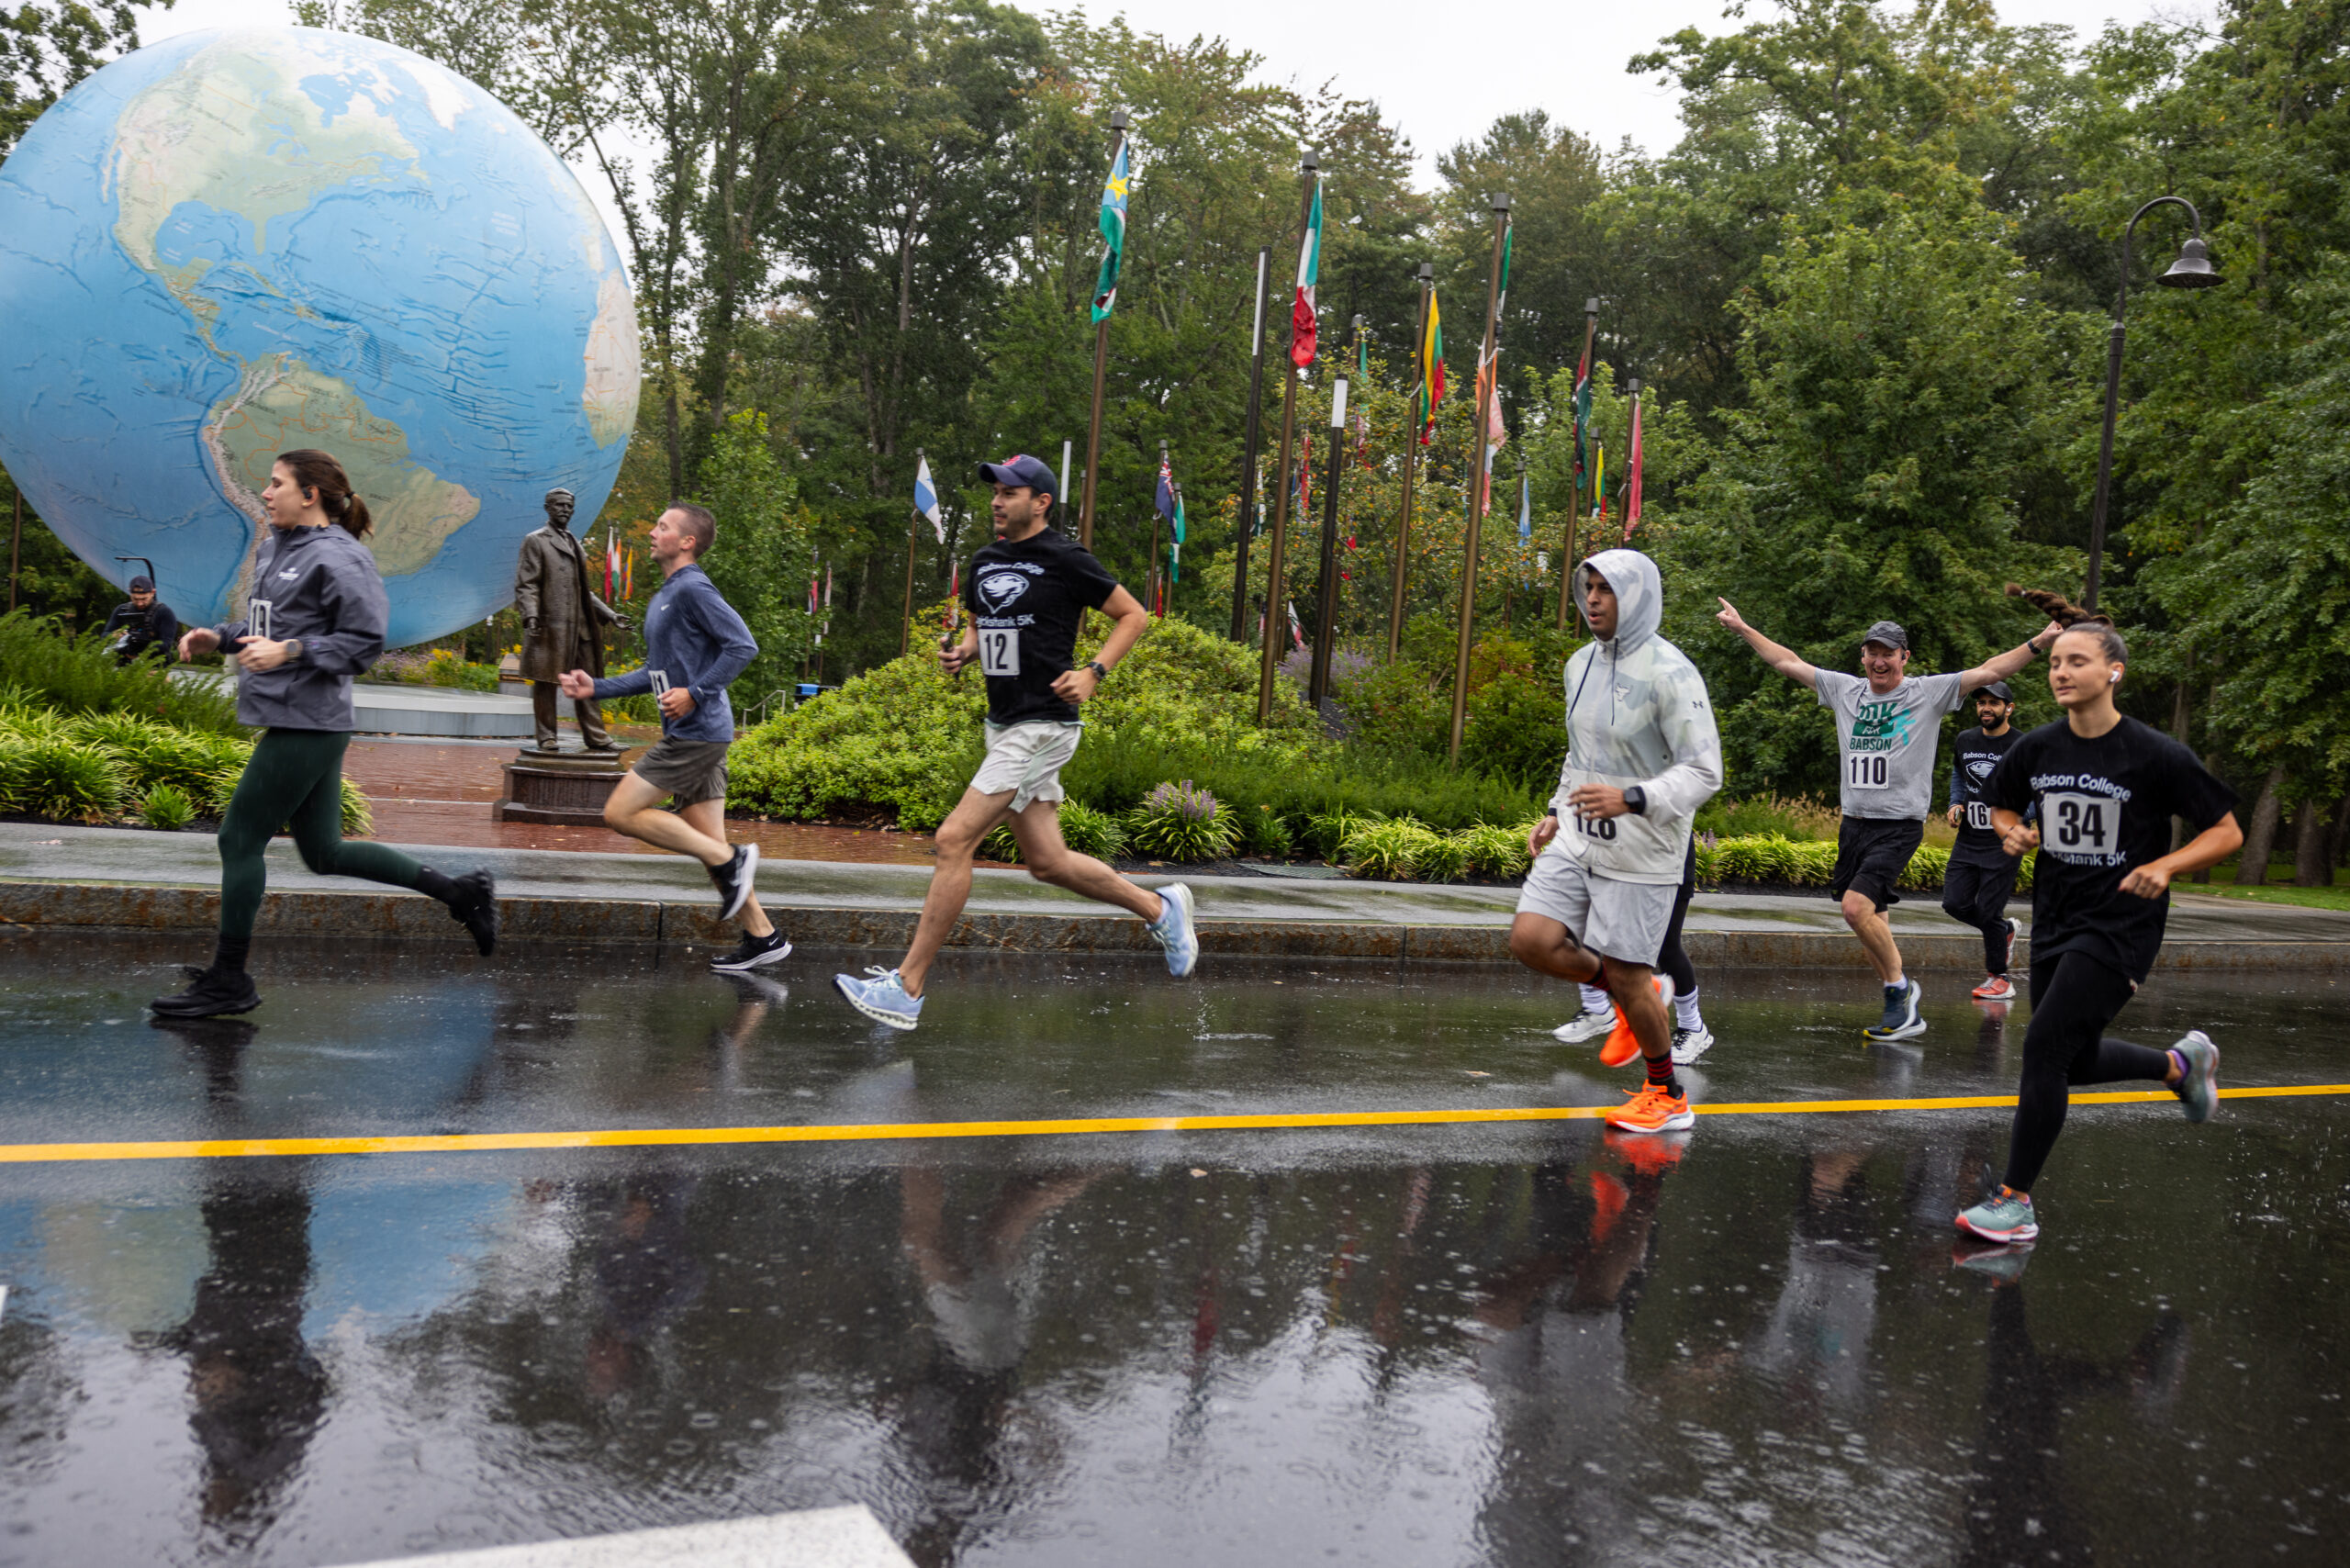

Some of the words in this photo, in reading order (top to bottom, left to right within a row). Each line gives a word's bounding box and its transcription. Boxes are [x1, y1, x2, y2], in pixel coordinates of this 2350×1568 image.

[985, 633, 1009, 670] 12
[1850, 737, 1893, 751] BABSON
[1963, 751, 1986, 760] Babson
[1851, 756, 1887, 785] 110
[2030, 773, 2075, 790] Babson
[2077, 773, 2132, 802] College
[2058, 800, 2107, 847] 34
[2107, 850, 2127, 867] 5K
